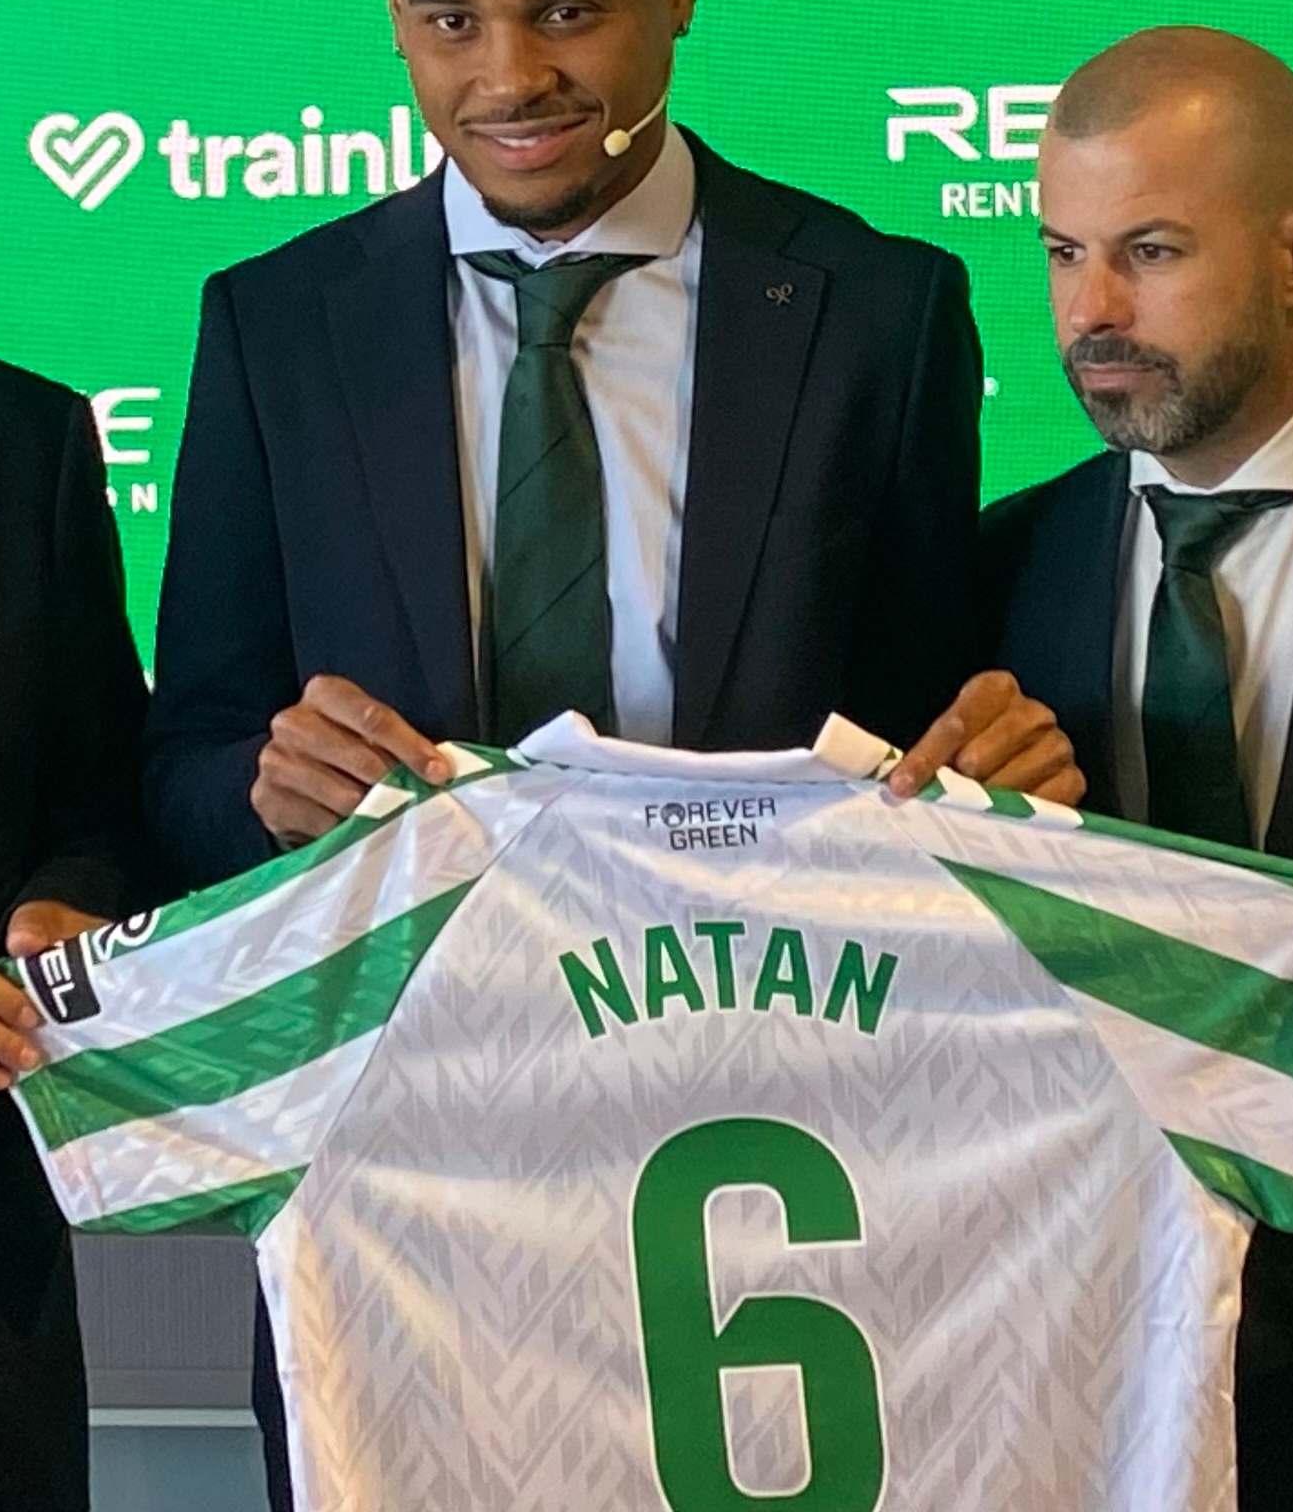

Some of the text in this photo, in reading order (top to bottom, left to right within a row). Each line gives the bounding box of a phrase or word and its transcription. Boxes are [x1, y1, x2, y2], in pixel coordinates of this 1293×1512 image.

[158, 105, 445, 199] trainl
[669, 822, 758, 851] GREEN
[558, 919, 899, 1039] NATAN
[628, 1115, 888, 1512] 6
